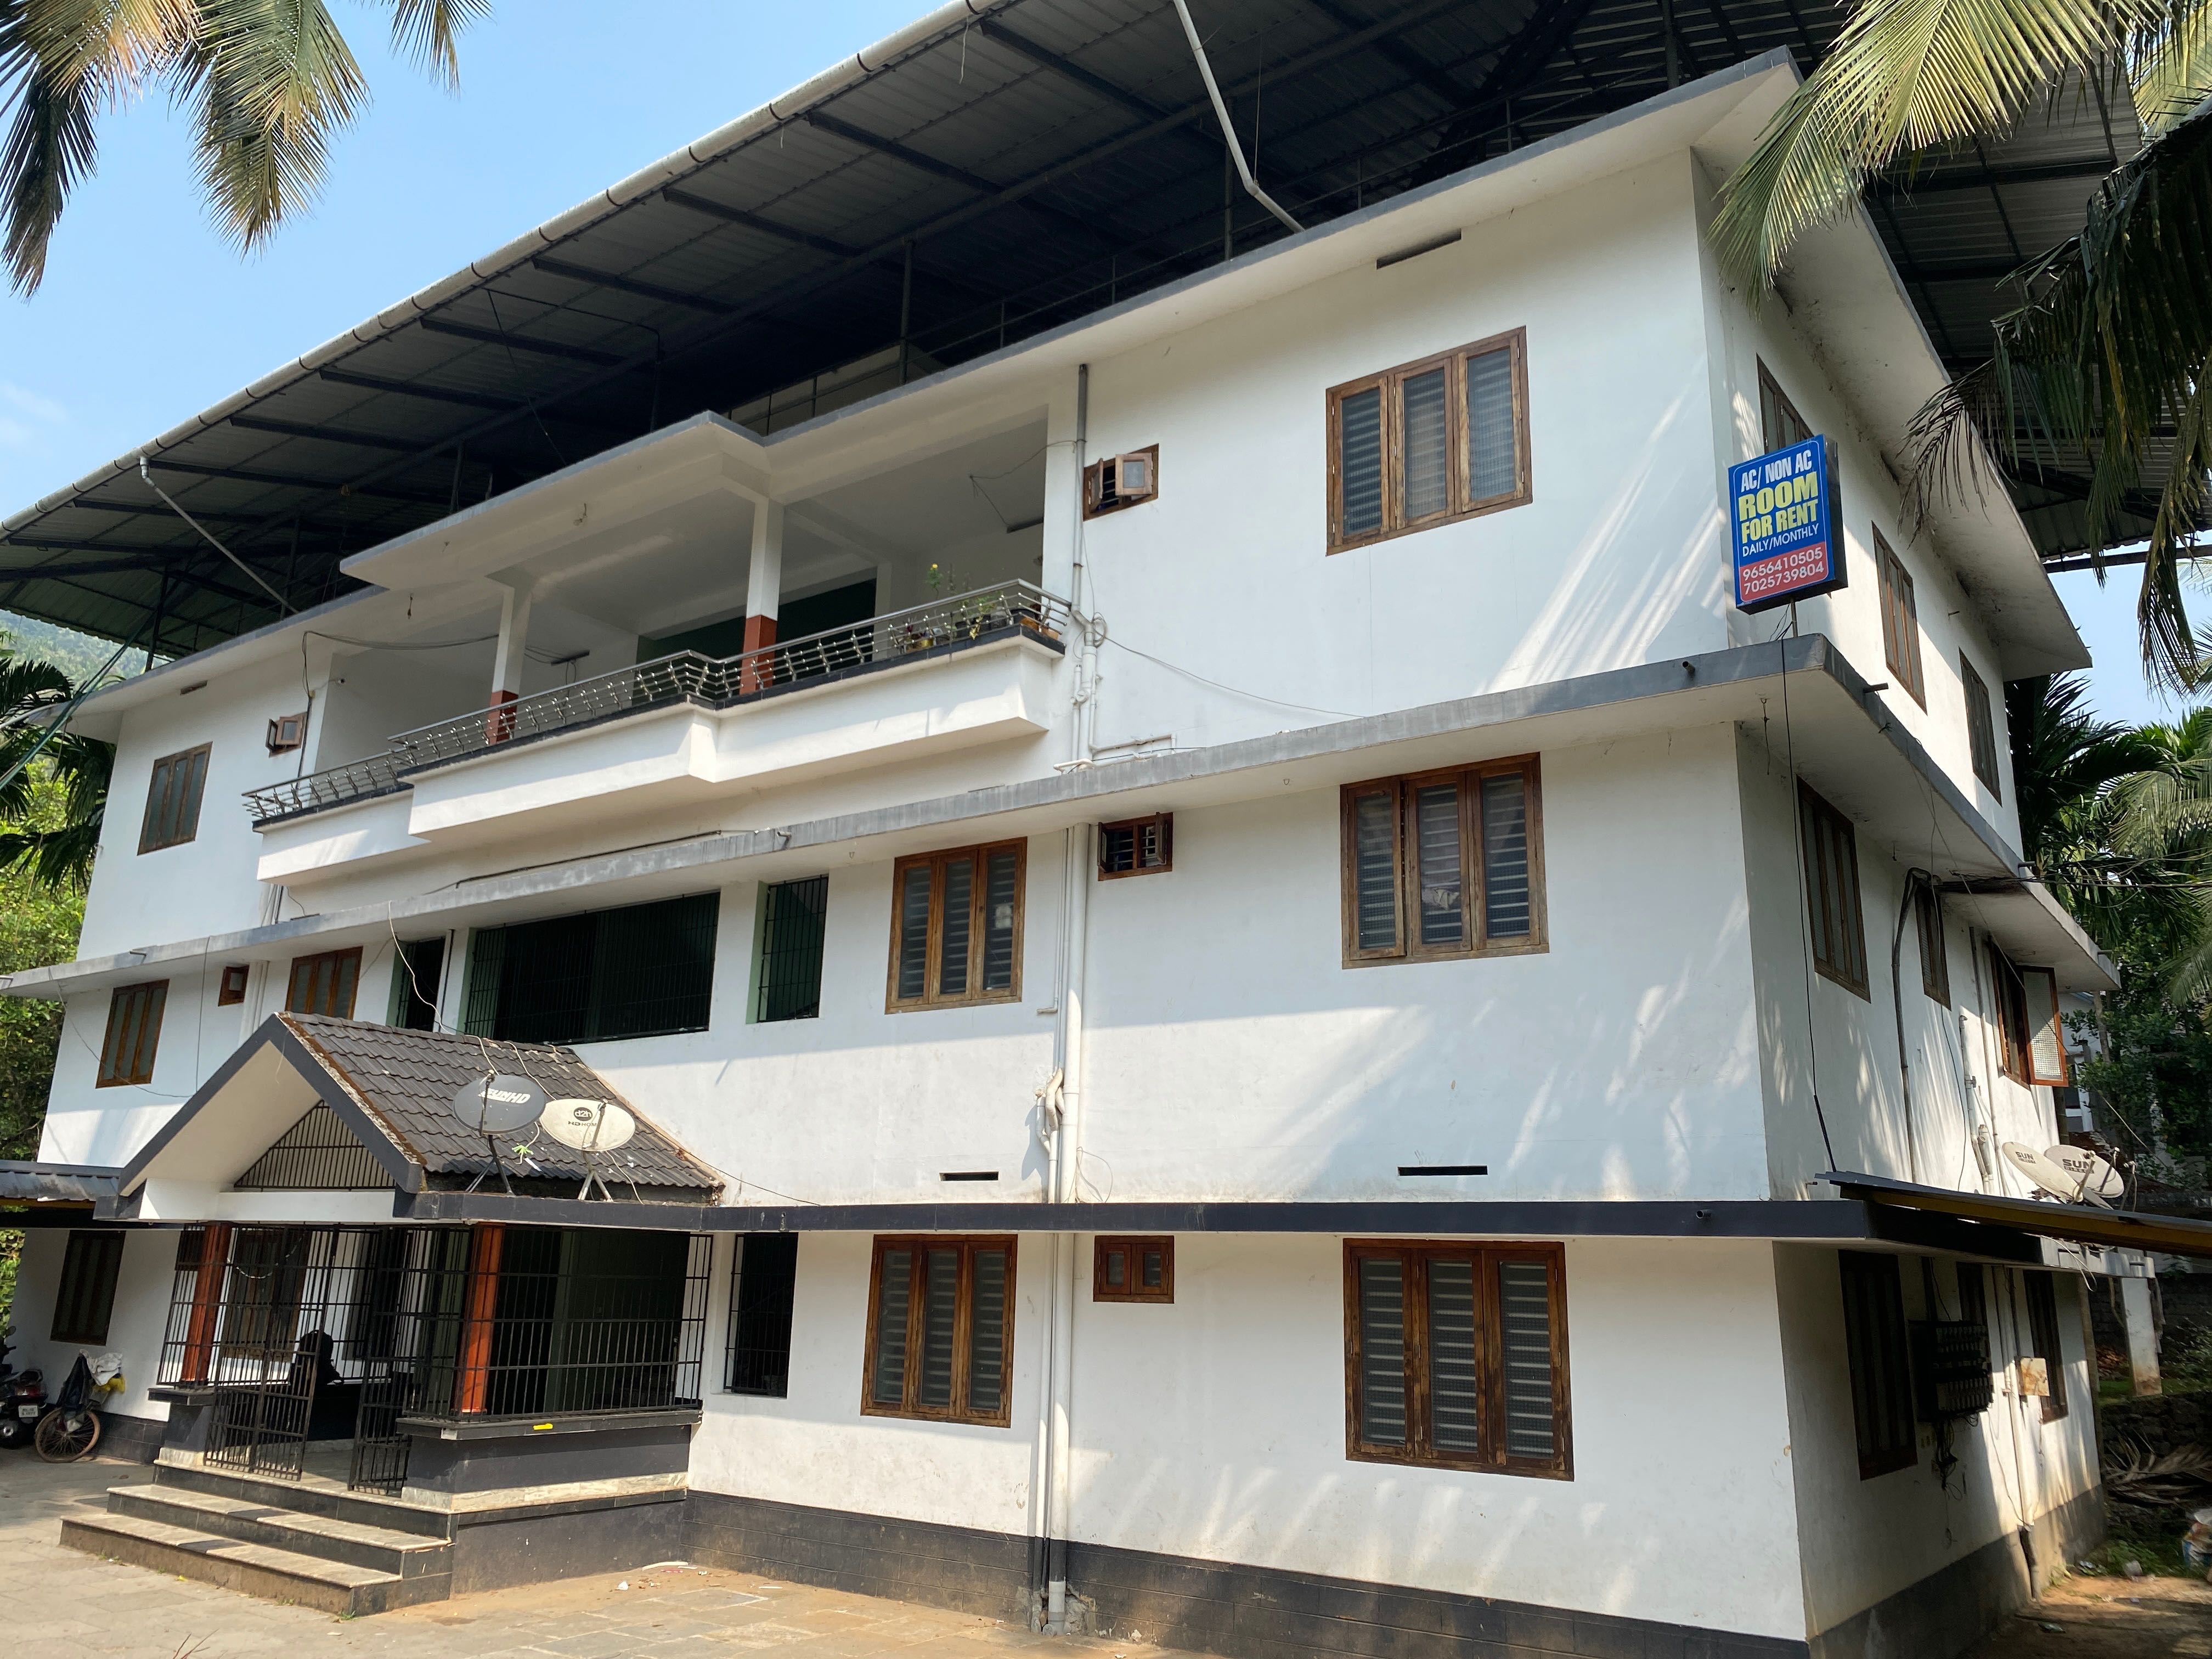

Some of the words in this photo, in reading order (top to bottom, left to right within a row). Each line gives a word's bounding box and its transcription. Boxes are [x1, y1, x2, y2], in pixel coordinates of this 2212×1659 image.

[1741, 466, 1762, 493] AC/
[1765, 456, 1792, 484] NON
[1795, 450, 1812, 474] AC
[1738, 471, 1819, 521] ROOM
[1742, 515, 1773, 544] FOR
[1776, 500, 1818, 533] RENT
[1742, 523, 1819, 557] DAILY/MONTHLY
[1742, 547, 1822, 581] 9656410505
[1743, 561, 1824, 595] 7025739804
[2015, 1152, 2034, 1160] SUN
